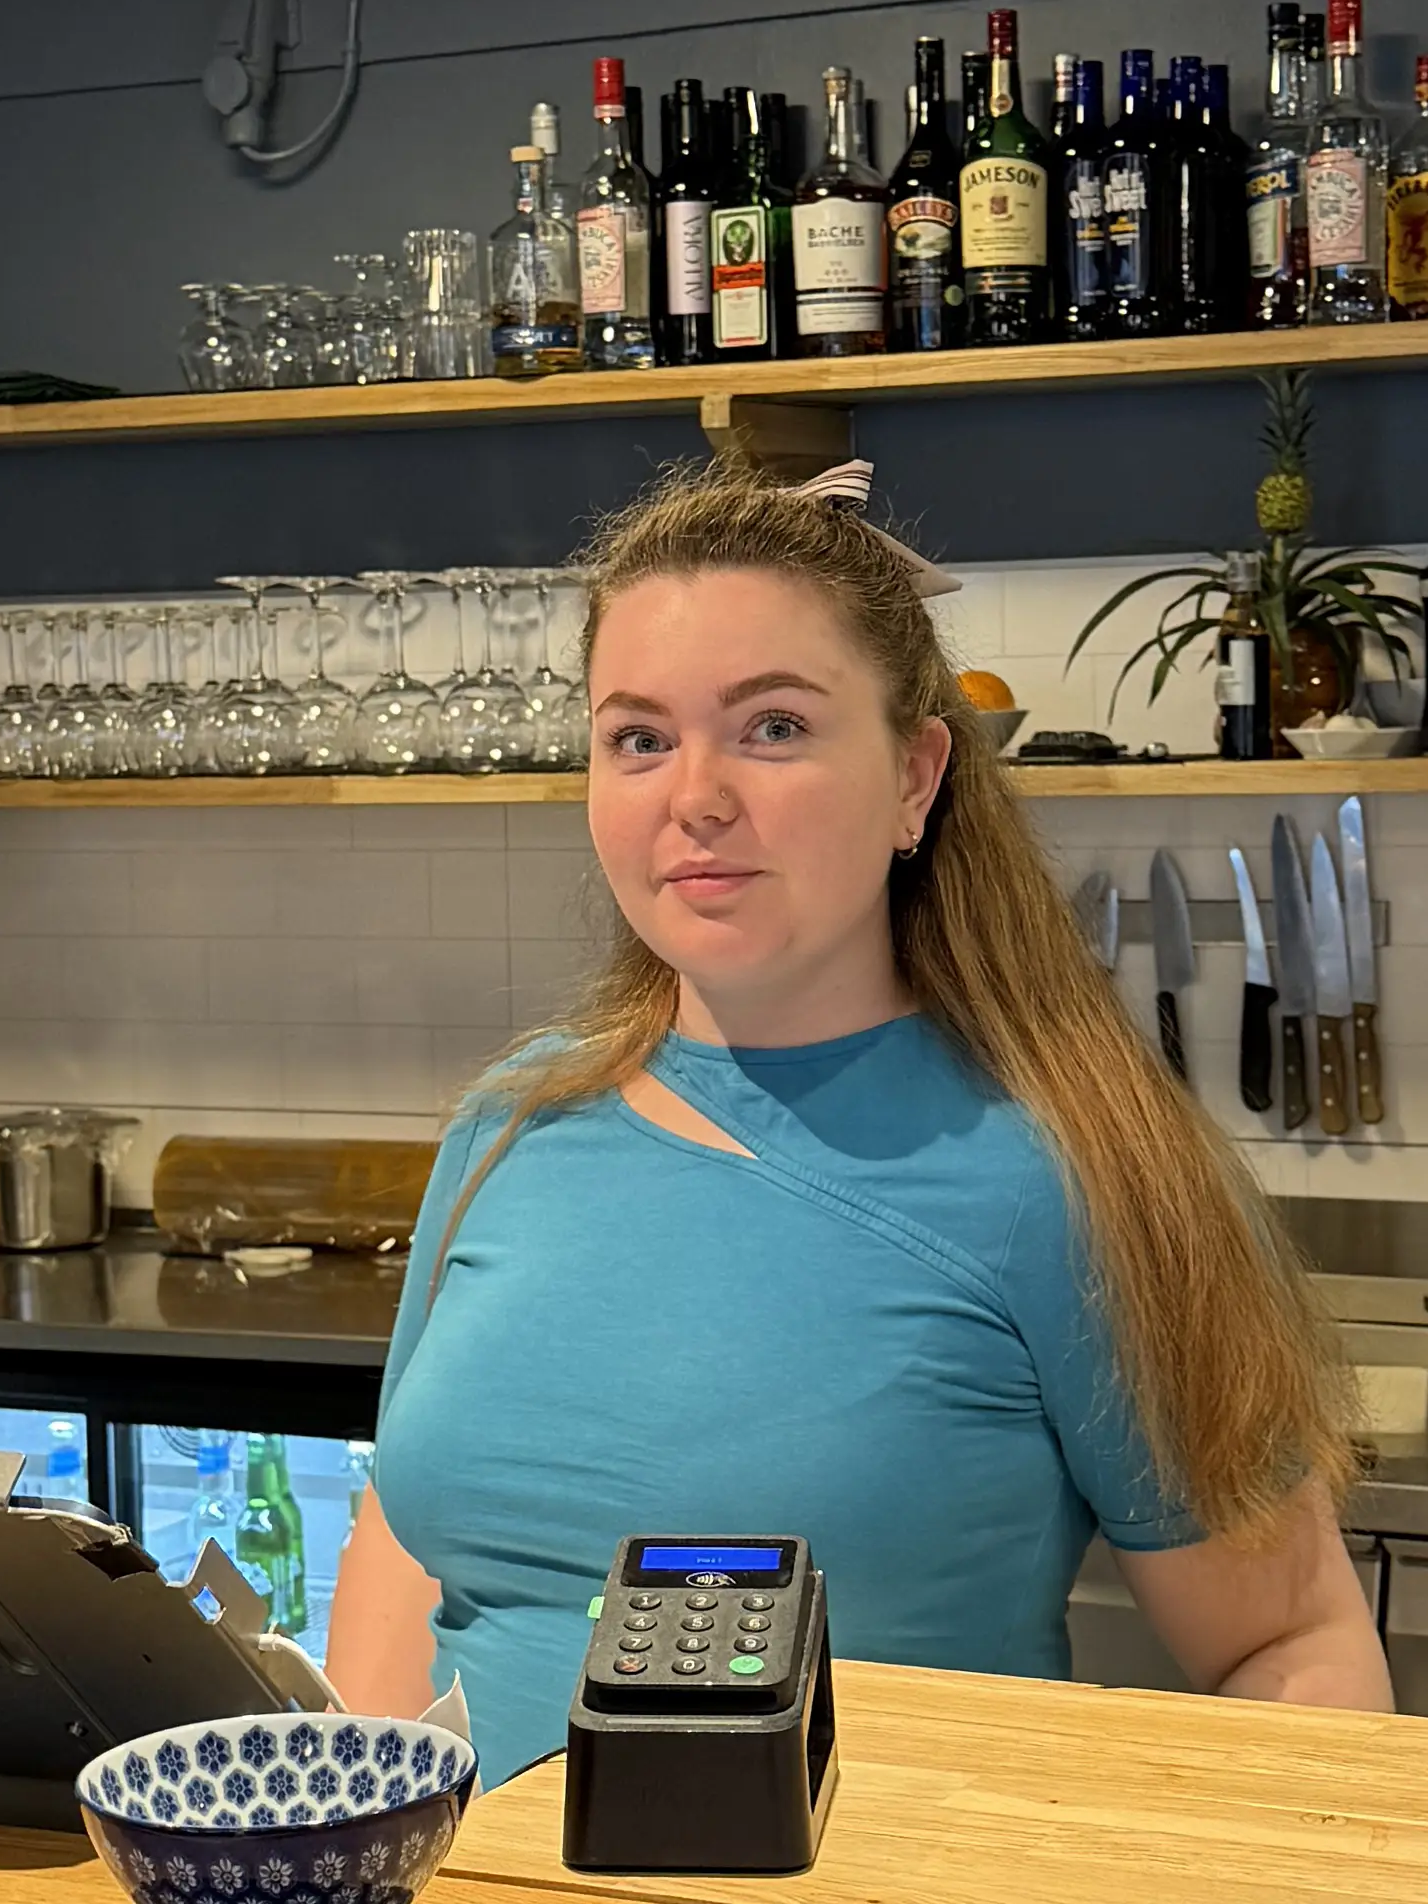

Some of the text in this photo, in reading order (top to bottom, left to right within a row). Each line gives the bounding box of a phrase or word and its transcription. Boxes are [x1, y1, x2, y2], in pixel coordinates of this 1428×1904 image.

[964, 166, 1040, 192] JAMESON
[808, 226, 865, 240] BACHE
[695, 1597, 707, 1606] 2
[752, 1597, 764, 1607] 3
[635, 1617, 760, 1629] 4 5 6
[631, 1638, 757, 1648] 7 8 9
[683, 1660, 695, 1670] 0
